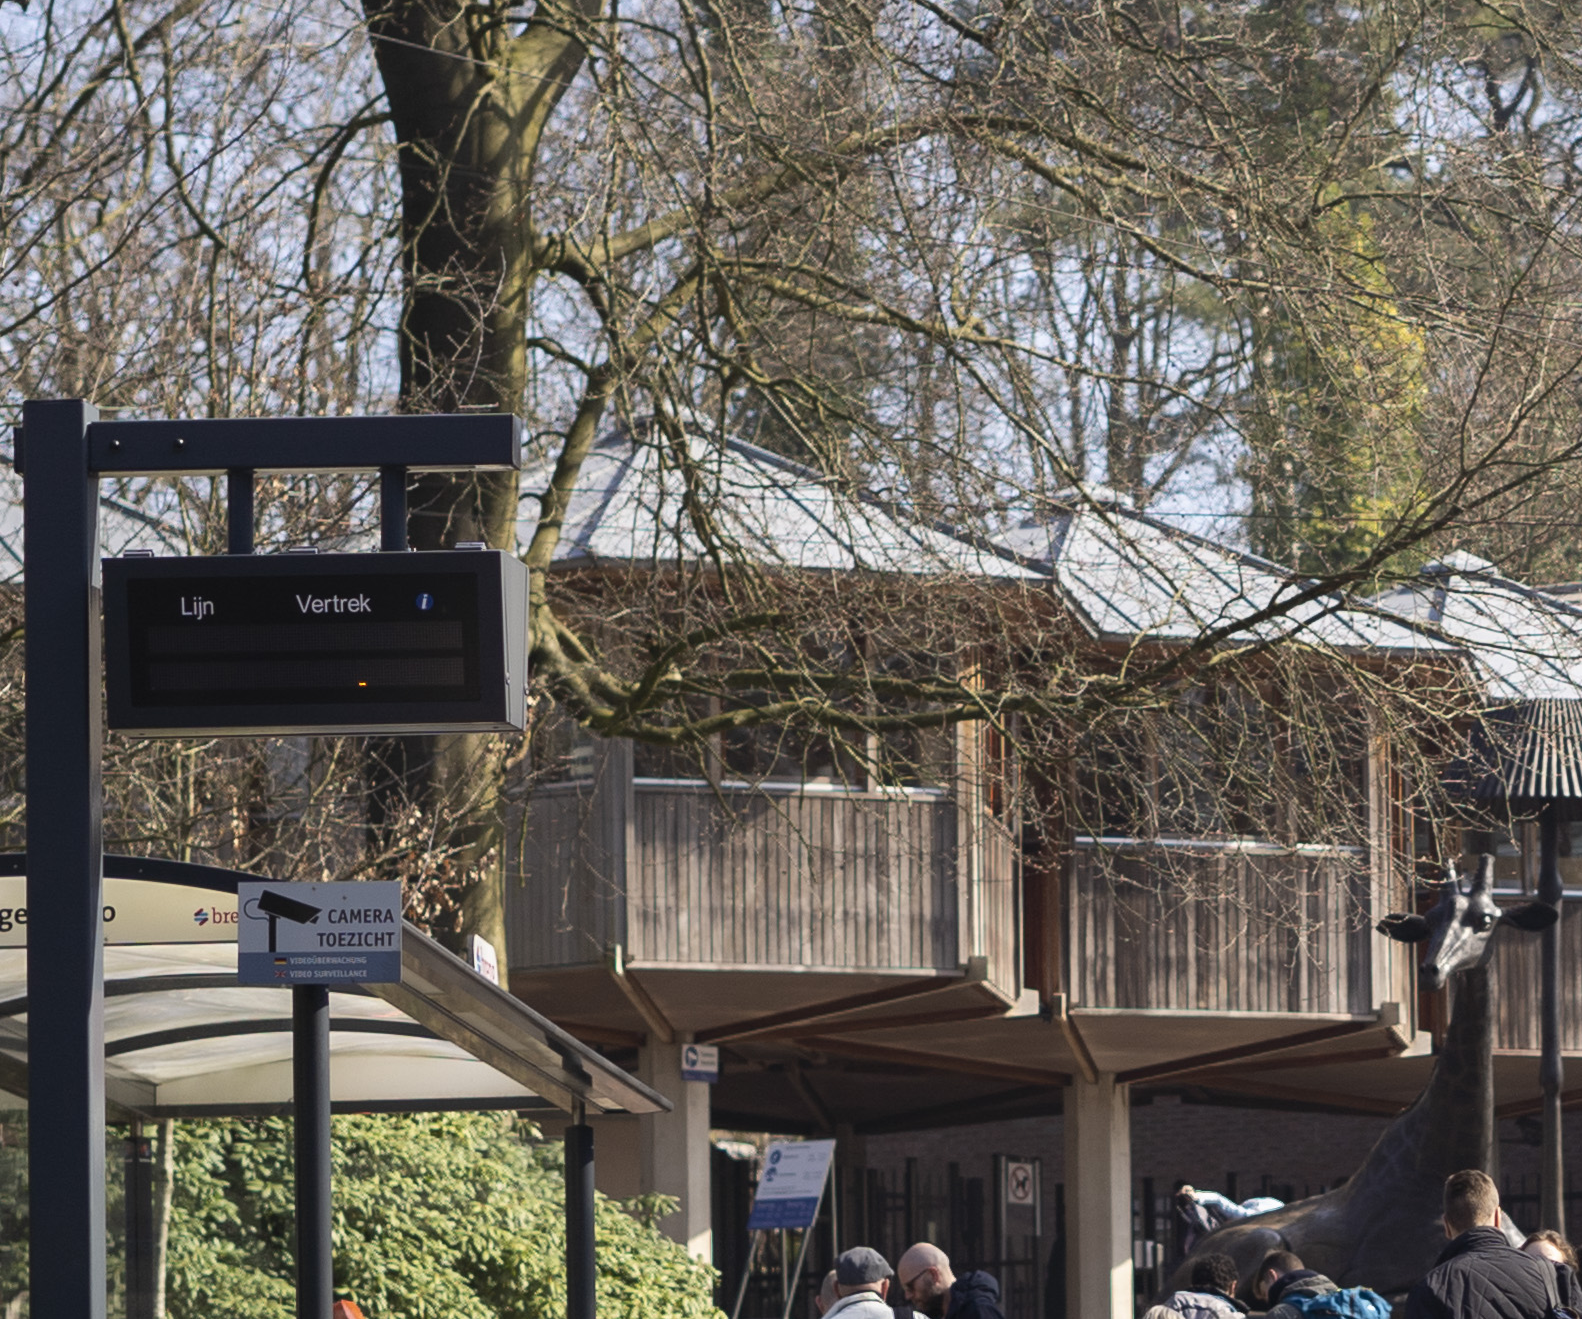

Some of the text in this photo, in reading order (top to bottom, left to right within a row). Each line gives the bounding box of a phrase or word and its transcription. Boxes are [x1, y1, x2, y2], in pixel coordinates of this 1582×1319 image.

[181, 597, 214, 620] Lijn
[296, 594, 372, 614] Vertrek
[212, 907, 239, 924] bre
[328, 908, 395, 924] CAMERA
[317, 932, 395, 947] TOEZICHT
[290, 969, 368, 978] VIDEO SURVEILLANCE
